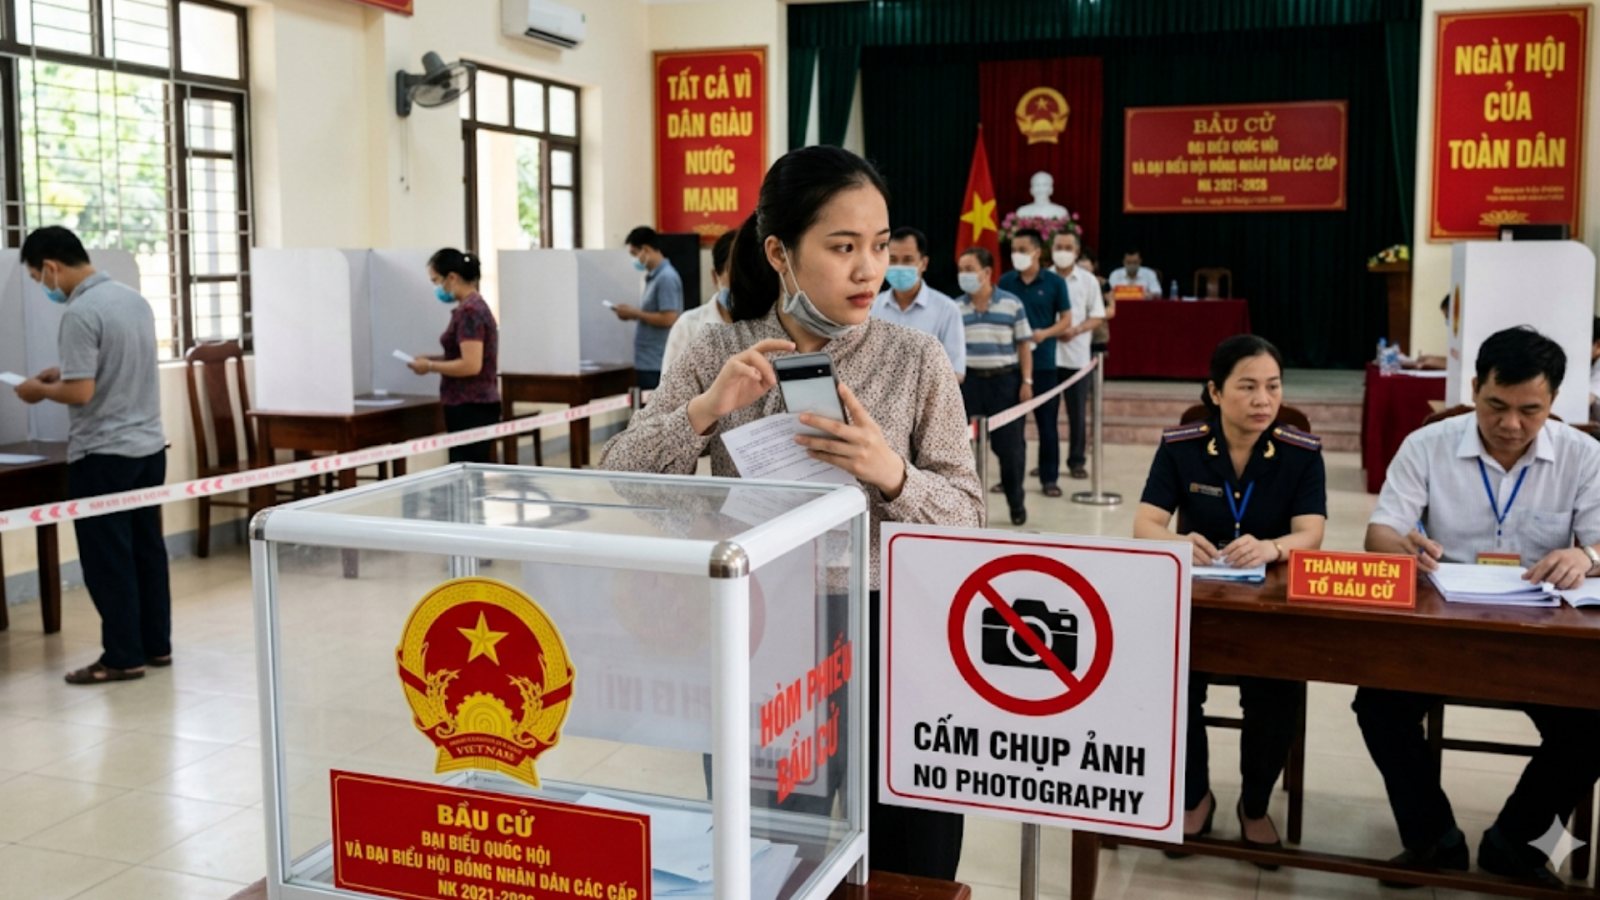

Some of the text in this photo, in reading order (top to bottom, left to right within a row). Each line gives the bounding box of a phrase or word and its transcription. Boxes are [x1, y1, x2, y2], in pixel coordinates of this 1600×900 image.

[1455, 35, 1565, 78] NGÀY HỘI
[668, 65, 751, 101] TẤT CẢ VÌ
[1484, 80, 1532, 122] CỦA
[668, 106, 752, 138] DÂN GIÀU
[685, 145, 735, 175] NƯỚC
[1449, 131, 1566, 169] TOÀN DÂN
[684, 187, 738, 217] MẠNH
[1303, 557, 1400, 578] THÀNH VIÊN
[760, 678, 801, 748] HÒM
[807, 632, 852, 712] PHIẾU
[914, 714, 1145, 776] CẤM CHỤP ẢNH
[914, 764, 1144, 815] NO PHOTOGRAPHY
[437, 801, 535, 838] BẦU CỬ
[484, 840, 522, 861] QUỐC
[526, 846, 550, 868] HỘI
[438, 879, 457, 897] NK
[574, 878, 603, 900] CÁC
[607, 881, 637, 900] CẤP
